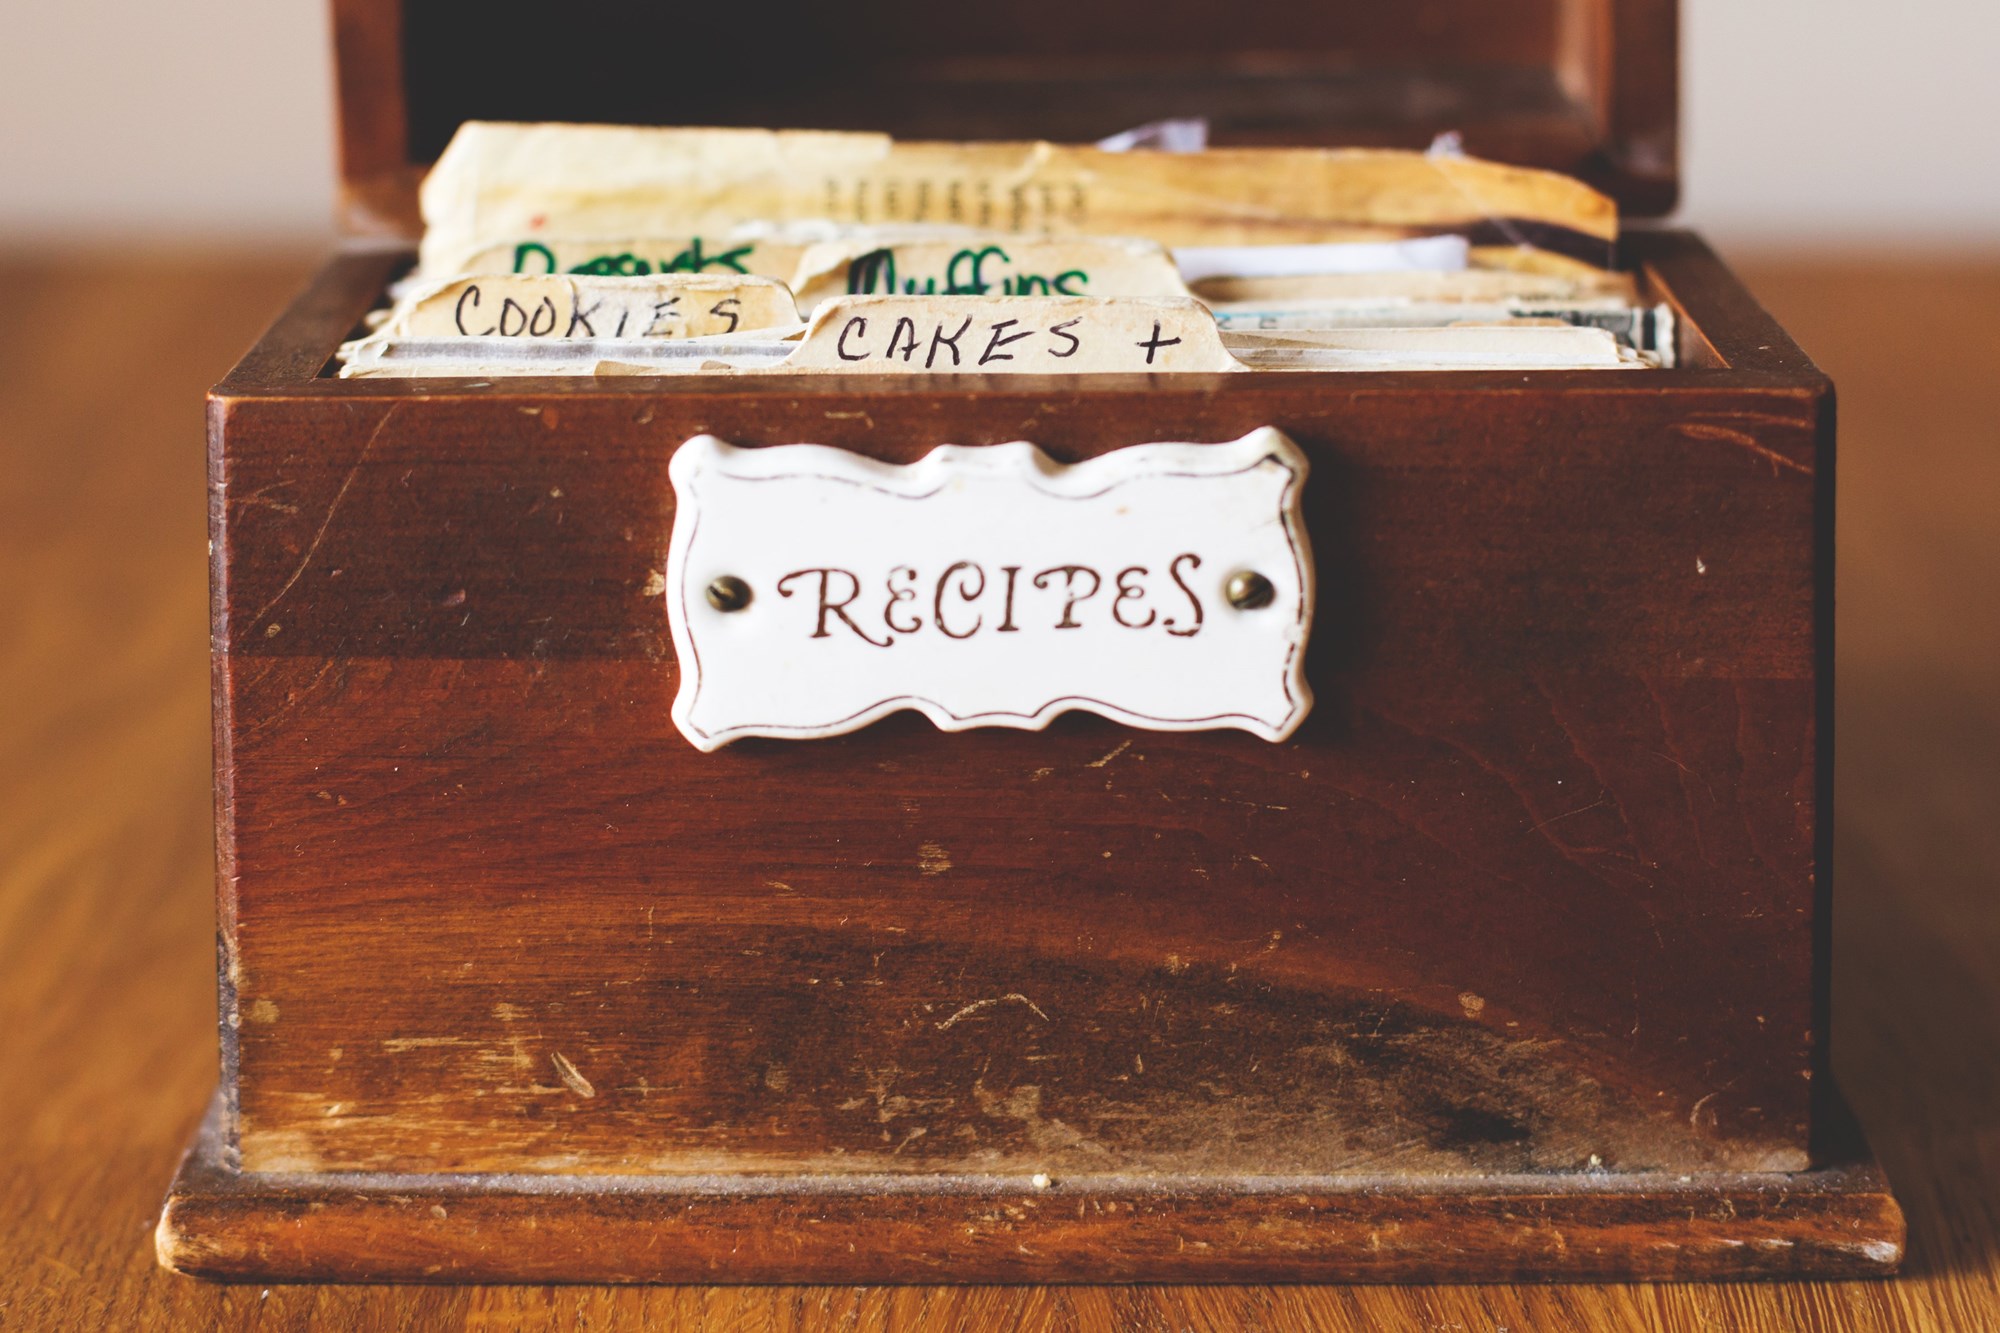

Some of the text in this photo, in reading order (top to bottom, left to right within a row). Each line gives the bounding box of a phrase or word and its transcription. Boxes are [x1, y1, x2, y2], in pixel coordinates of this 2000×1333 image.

[848, 246, 1089, 296] Muffins
[455, 284, 741, 337] COOKIES
[837, 313, 1083, 369] CAKES
[777, 551, 1204, 648] RECIPES
